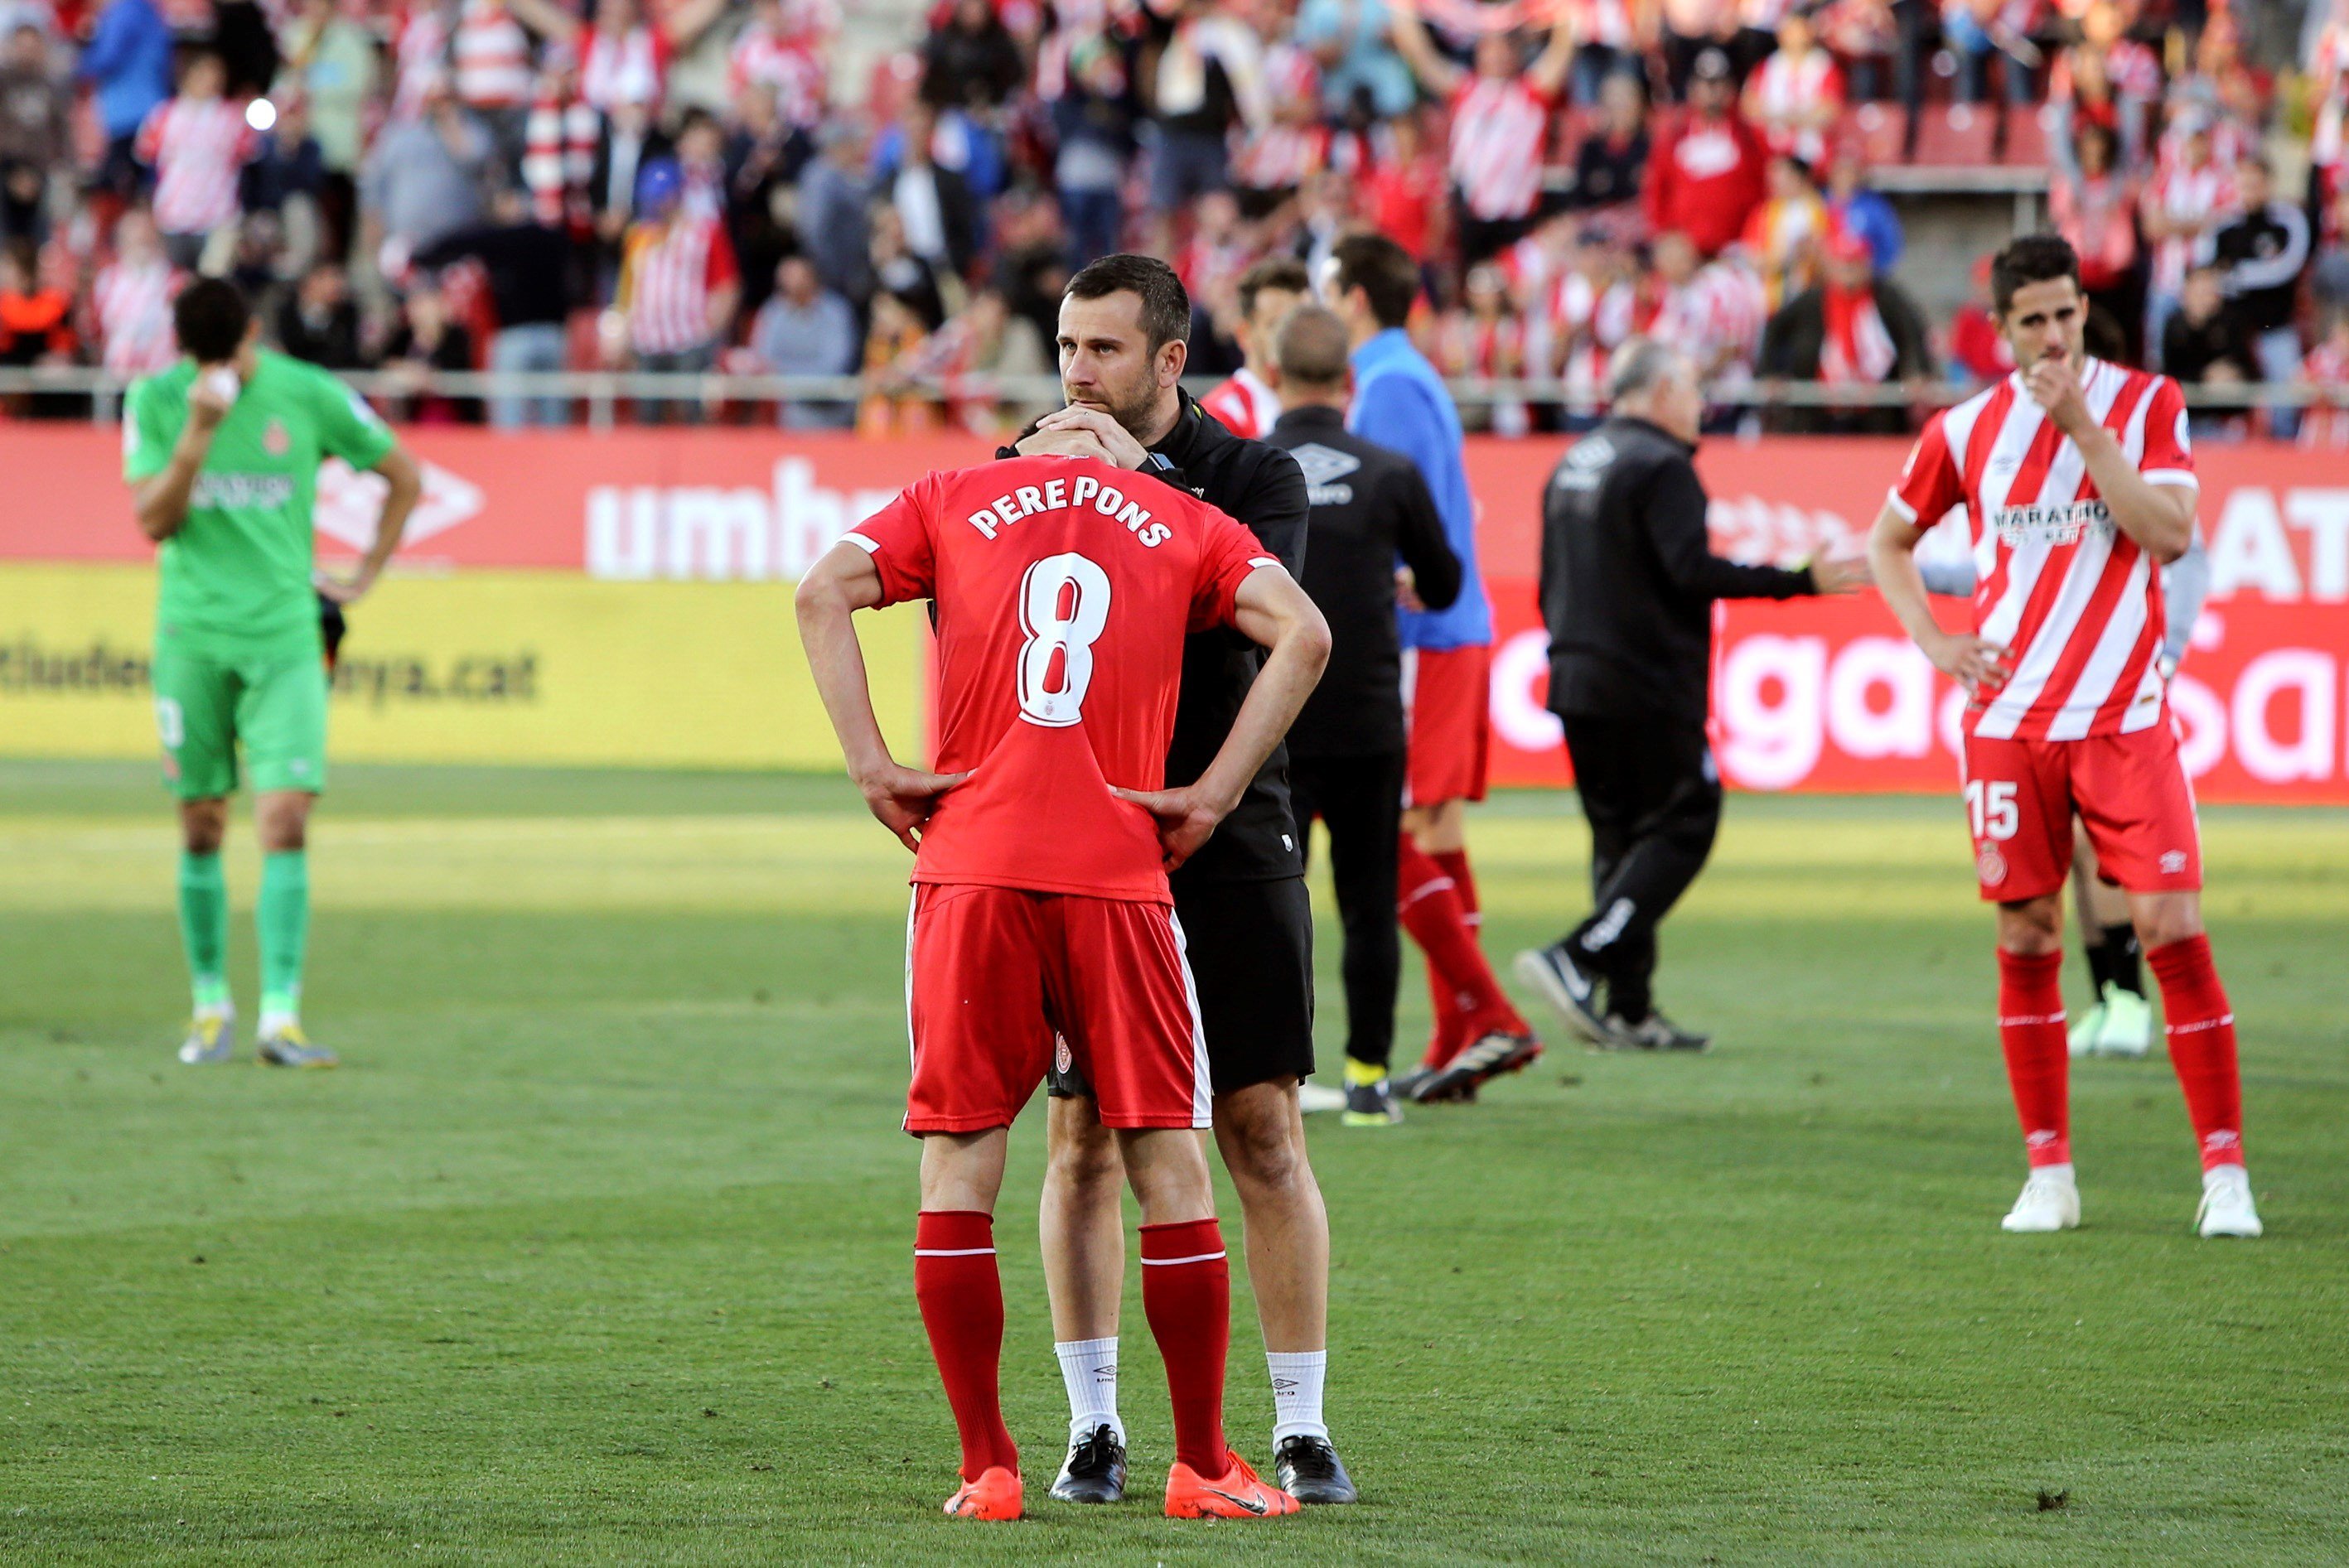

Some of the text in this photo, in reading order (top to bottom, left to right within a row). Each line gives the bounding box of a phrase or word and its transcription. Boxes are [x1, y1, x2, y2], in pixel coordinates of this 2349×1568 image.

[968, 475, 1172, 548] PERE PONS
[1017, 552, 1111, 727] 8
[1965, 779, 2019, 840] 15
